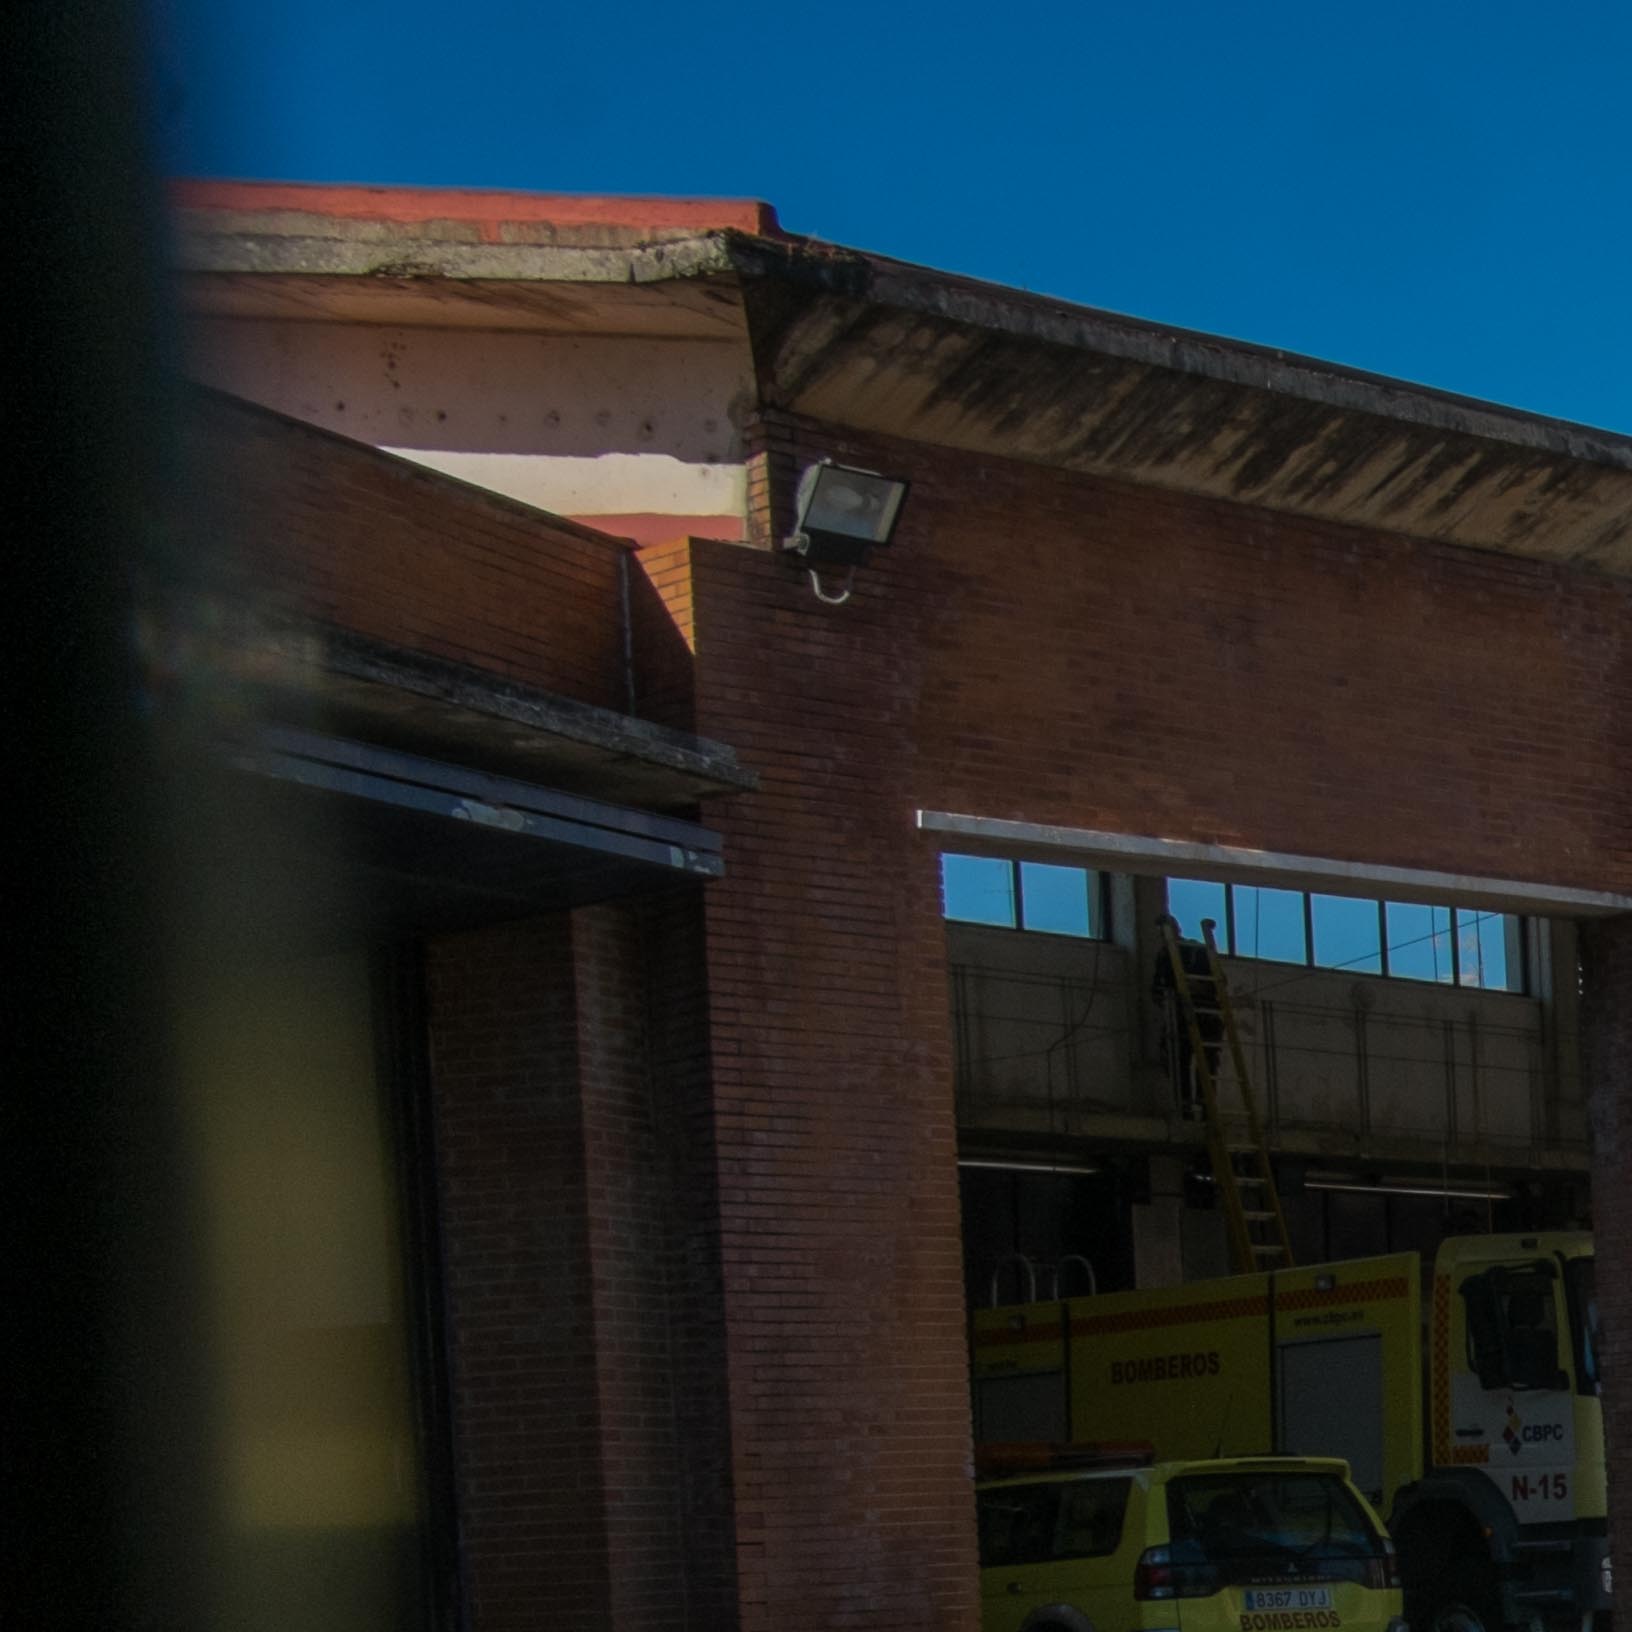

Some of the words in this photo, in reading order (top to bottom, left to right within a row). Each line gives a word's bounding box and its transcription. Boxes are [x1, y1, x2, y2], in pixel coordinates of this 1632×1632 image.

[1112, 1352, 1220, 1384] BOMBEROS
[1522, 1424, 1563, 1442] CBPC
[1512, 1474, 1567, 1501] N-15
[1256, 1592, 1292, 1608] 8367
[1300, 1590, 1327, 1607] DYJ
[1239, 1611, 1341, 1632] BOMBEROS
